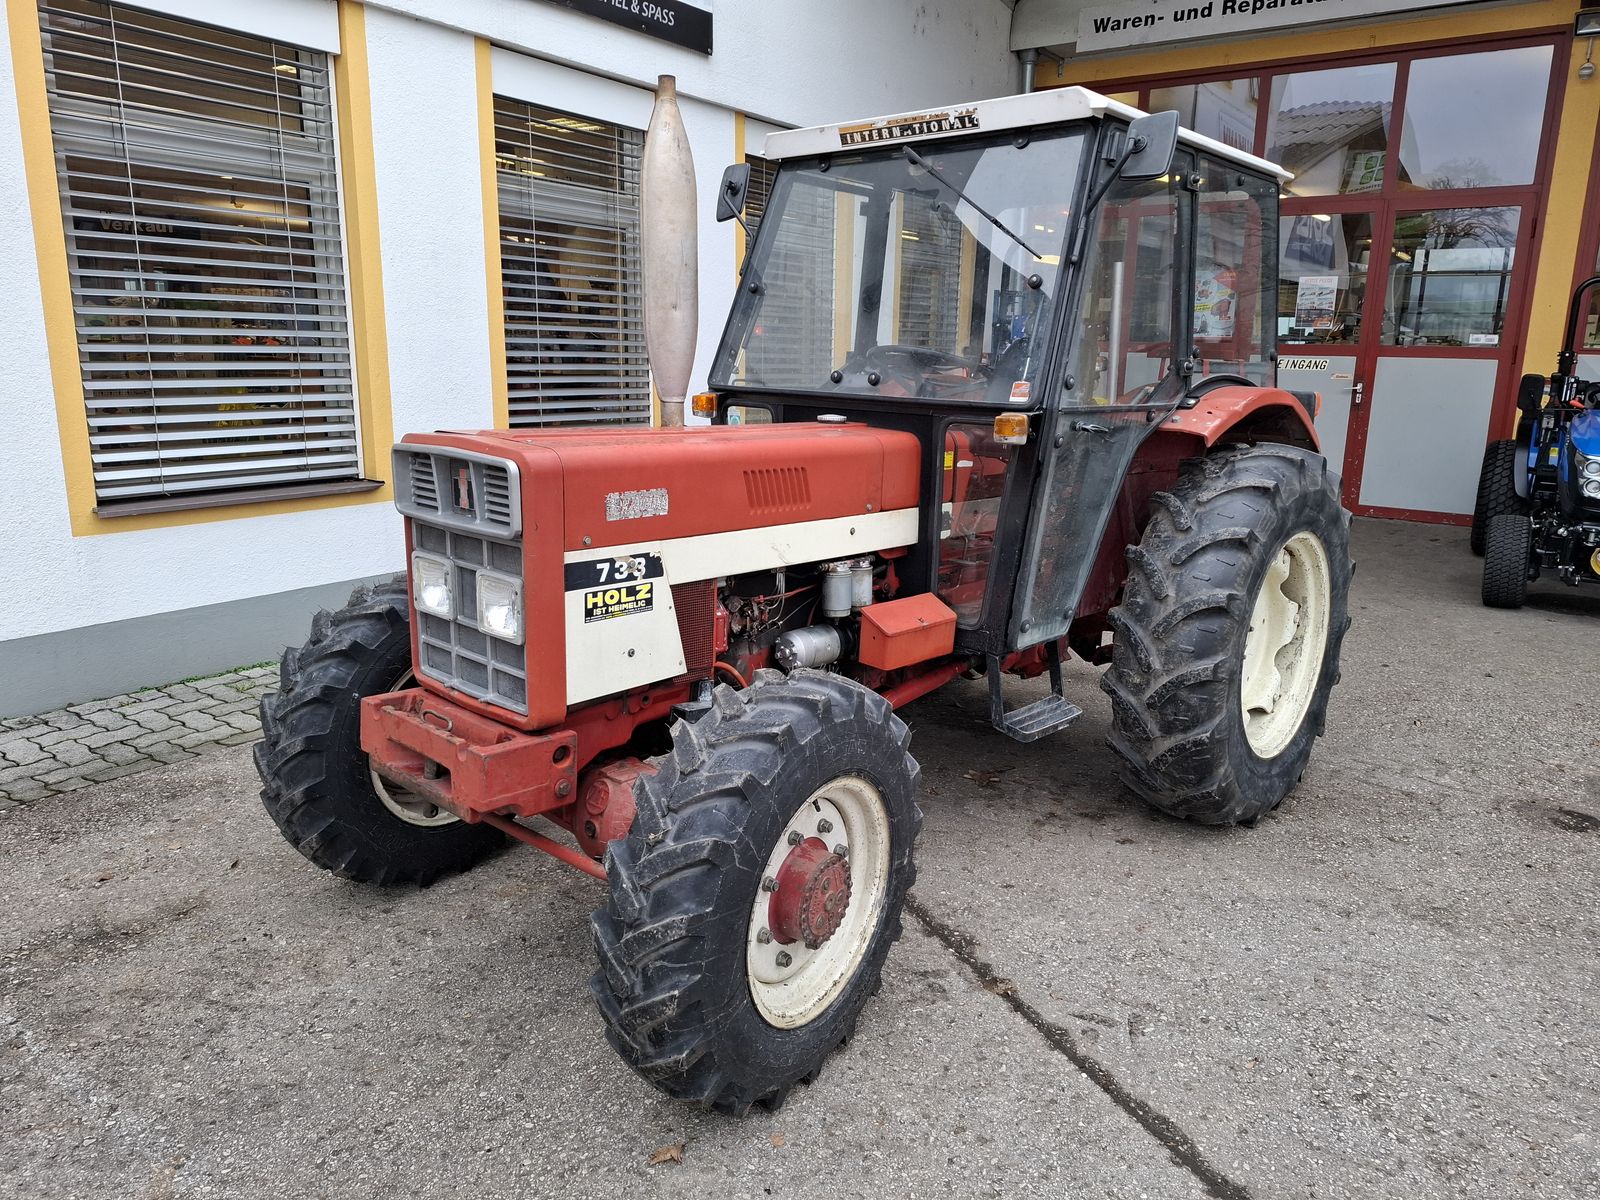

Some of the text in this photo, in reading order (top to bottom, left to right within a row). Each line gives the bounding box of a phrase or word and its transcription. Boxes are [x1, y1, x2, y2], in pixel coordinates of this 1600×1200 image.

[604, 0, 675, 26] EL & SPASS
[1093, 0, 1328, 34] Waren- und Repara
[1277, 359, 1328, 370] EINGANG
[587, 583, 651, 609] HOLZ
[593, 607, 607, 616] IST
